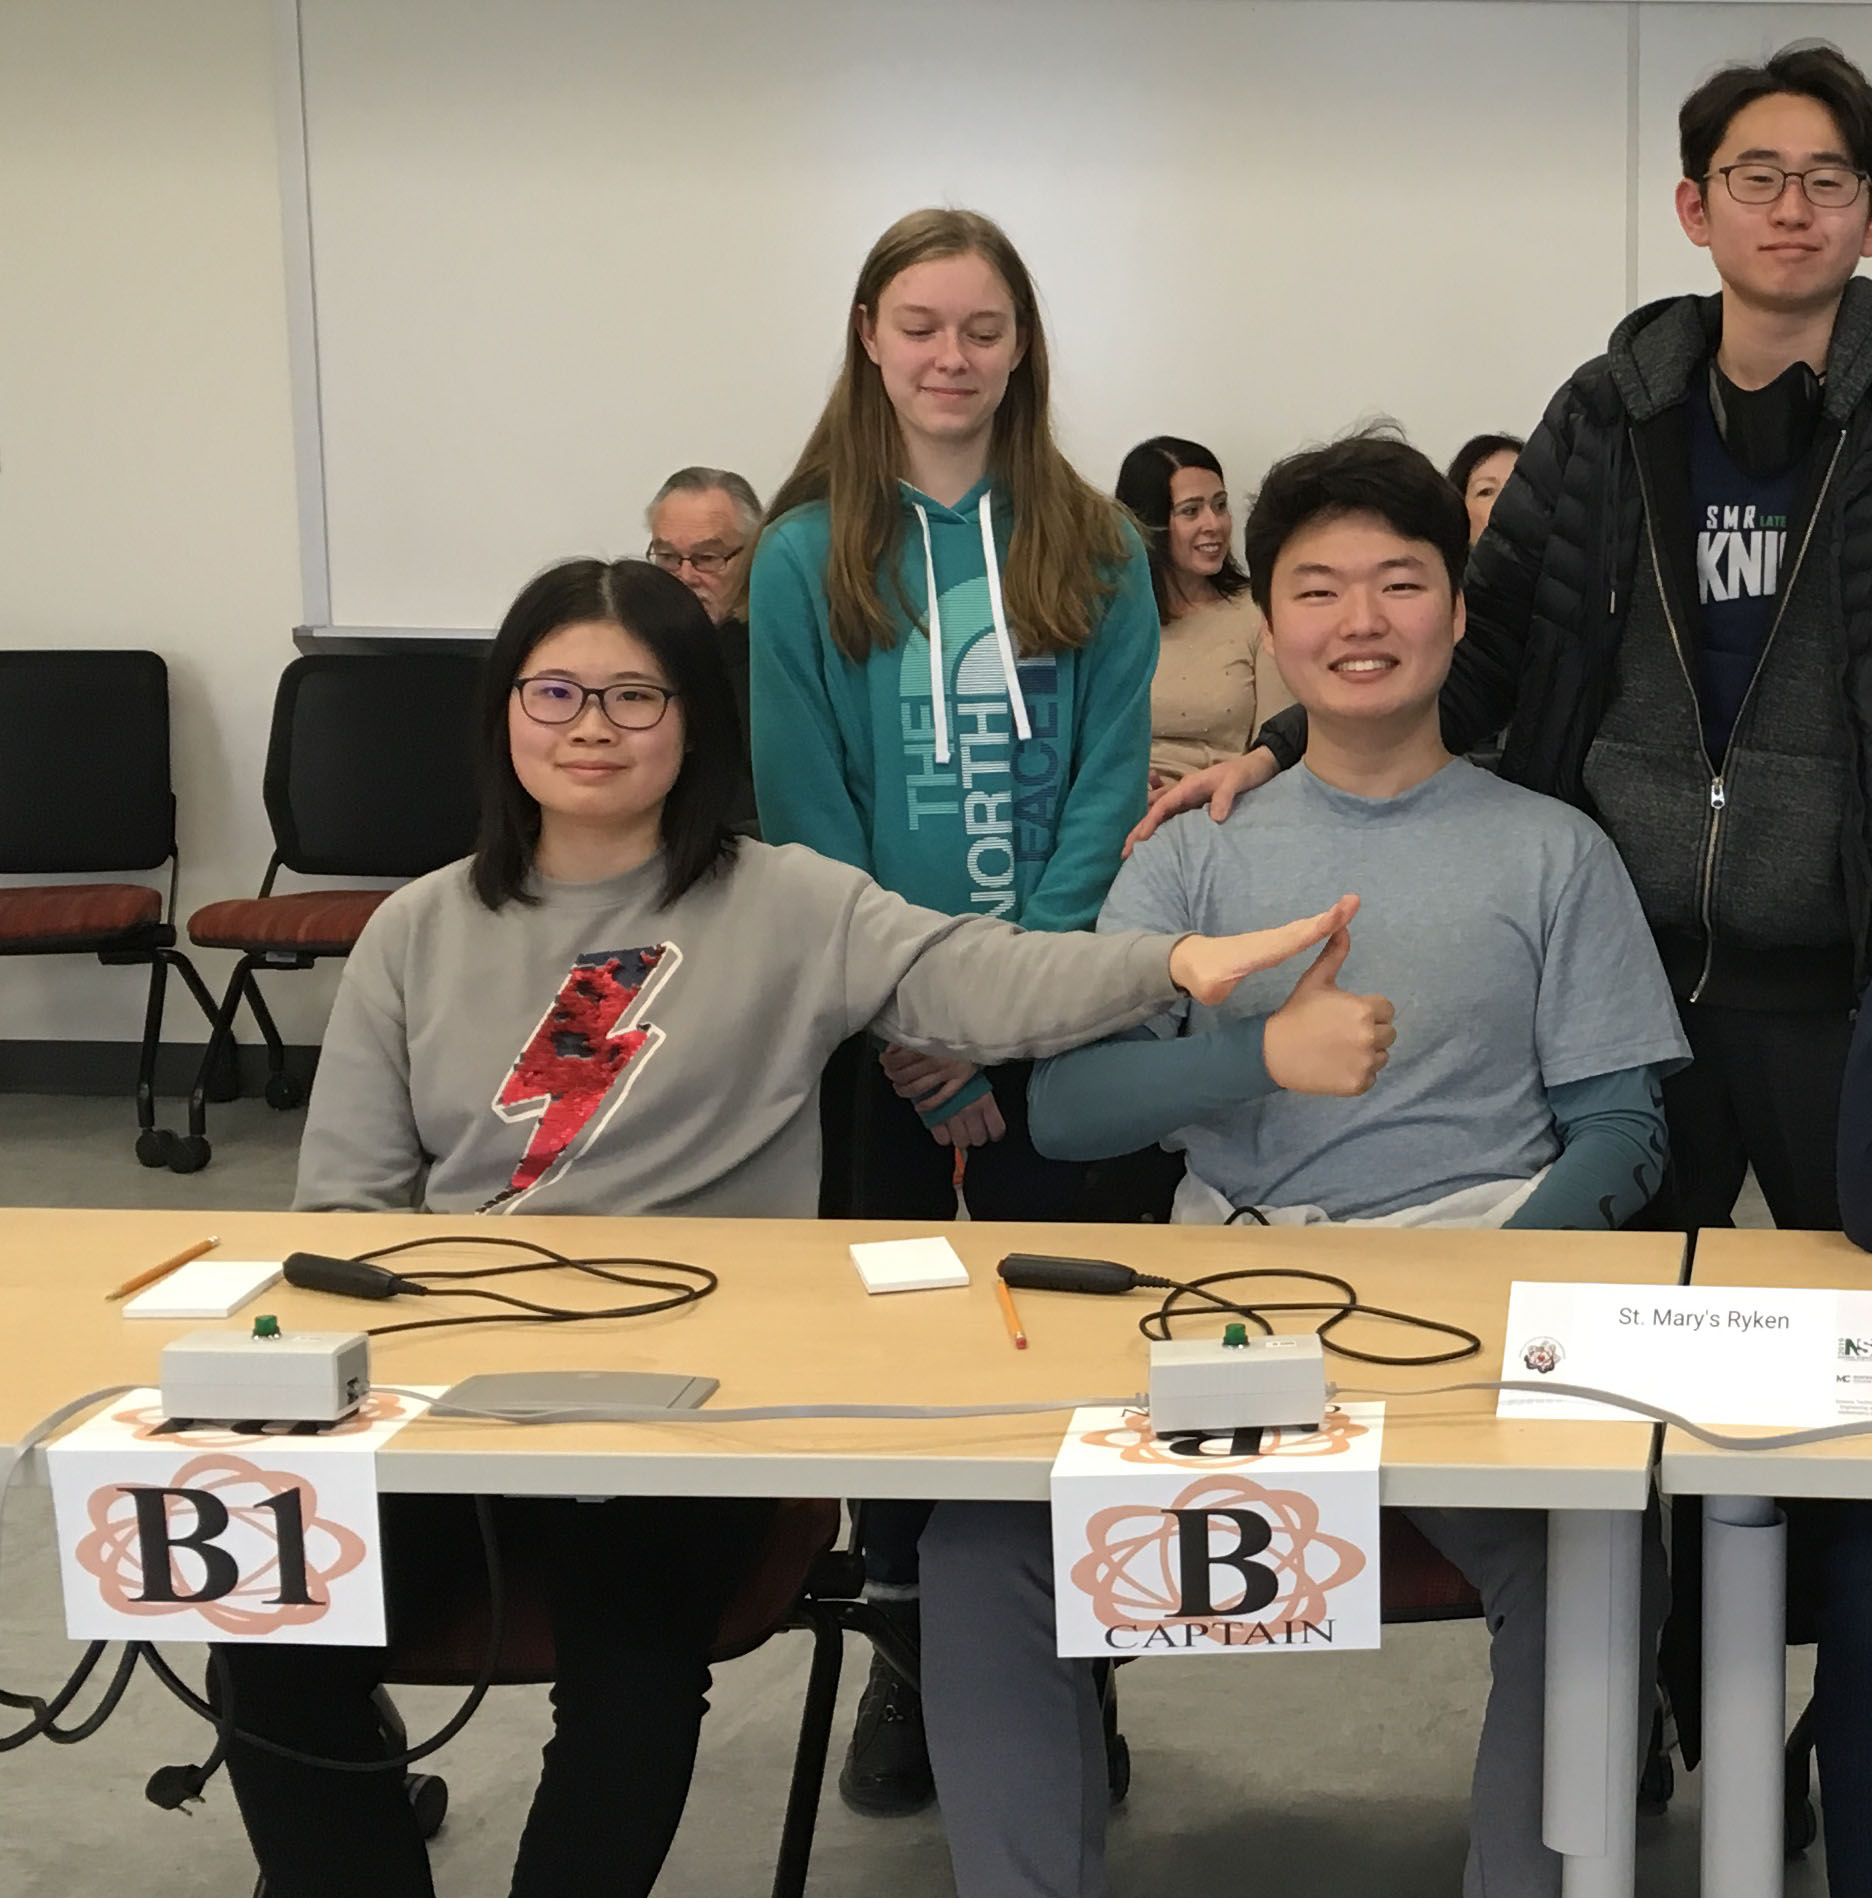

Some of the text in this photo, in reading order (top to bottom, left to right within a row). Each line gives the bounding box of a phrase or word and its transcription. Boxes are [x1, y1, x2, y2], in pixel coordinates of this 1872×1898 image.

[1697, 530, 1787, 604] KNI
[901, 701, 959, 830] THE
[1011, 702, 1058, 862] FACE
[1618, 1307, 1790, 1333] St. Mary's Ryken
[116, 1486, 327, 1606] B1
[1160, 1508, 1279, 1617] B
[1104, 1619, 1337, 1649] CAPTAIN
